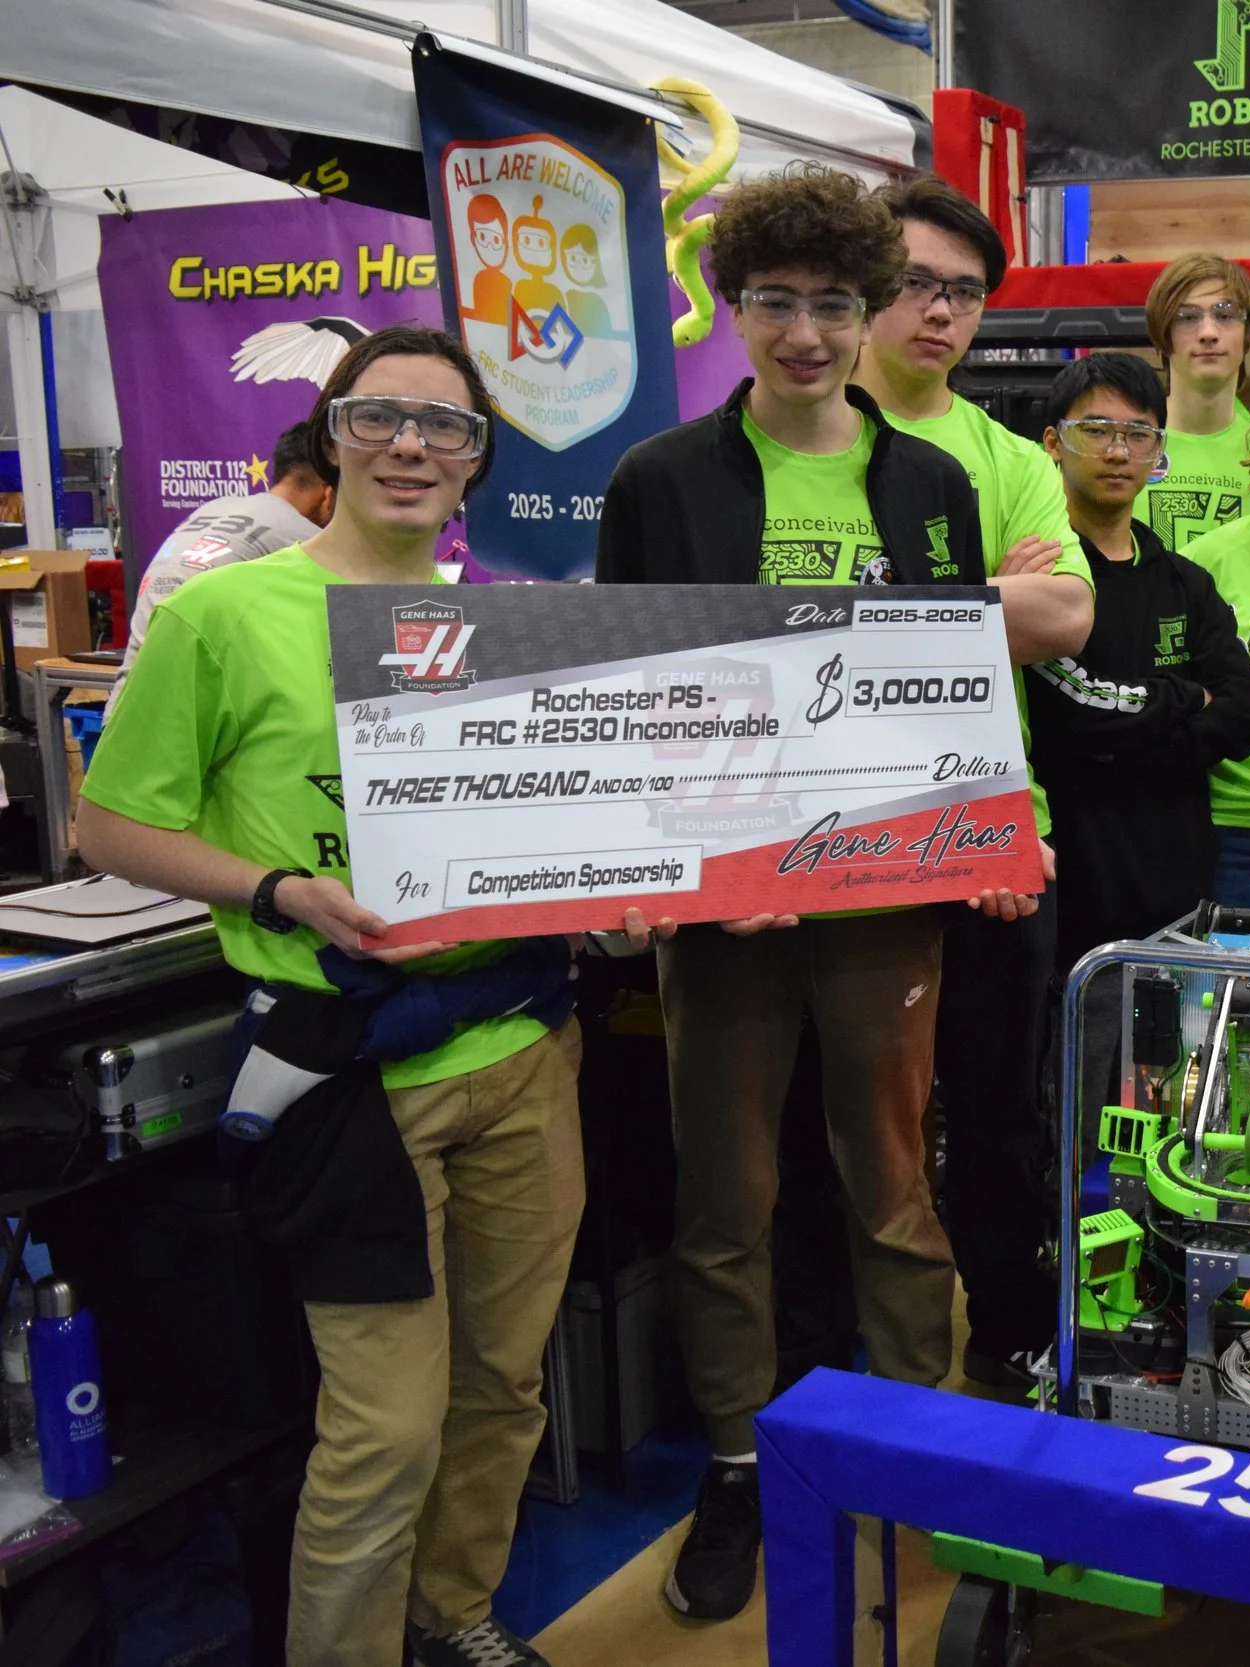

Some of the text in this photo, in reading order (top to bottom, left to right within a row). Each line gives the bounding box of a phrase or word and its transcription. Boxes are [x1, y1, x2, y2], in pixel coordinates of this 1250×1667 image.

[454, 153, 614, 225] ALL ARE WELCOME
[358, 243, 440, 296] HIG
[477, 349, 619, 404] FRC STUDENT LEADERSHIP
[524, 404, 580, 426] PROGRAM
[160, 460, 248, 478] DISTRICT 112
[161, 479, 249, 498] FOUNDATION
[508, 492, 554, 520] 2025
[1160, 497, 1198, 513] 2530
[760, 550, 820, 571] 2530
[400, 611, 456, 619] GENE HAAS
[785, 603, 983, 627] Date 2025-2026
[407, 681, 461, 690] FOUNDATION
[655, 670, 761, 686] GENE HAAS
[805, 652, 991, 731] $ 3,000.00
[531, 687, 663, 713] Rochester
[667, 684, 704, 710] PS
[352, 702, 392, 726] Pay to
[355, 722, 427, 749] the Order Of
[459, 713, 779, 747] FRC #2530 Inconceivable
[931, 752, 1012, 782] Dollars
[365, 769, 675, 806] THREE THOUSAND AND 00/100
[675, 815, 776, 833] FOUNDATION
[776, 803, 1018, 876] Gene Haas
[395, 857, 684, 904] For Competition Sponsorship
